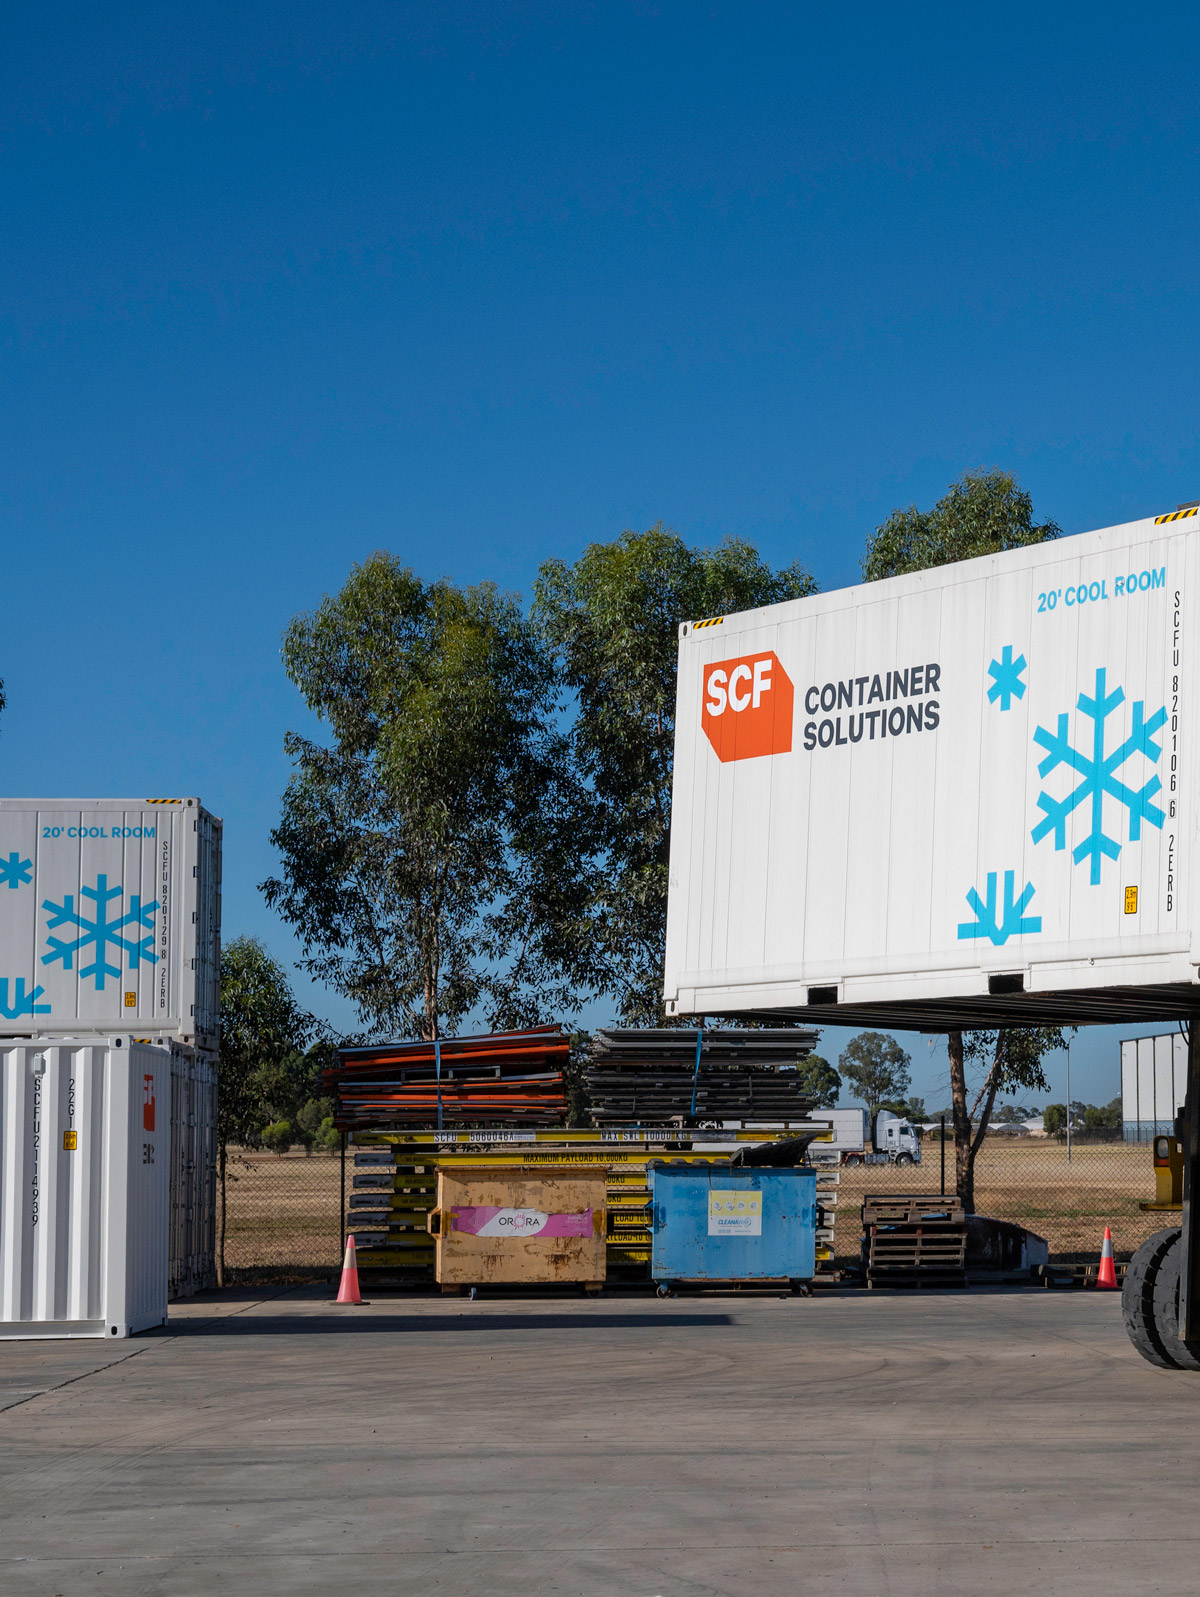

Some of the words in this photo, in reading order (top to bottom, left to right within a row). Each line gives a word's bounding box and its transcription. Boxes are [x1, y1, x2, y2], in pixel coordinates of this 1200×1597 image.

[1037, 588, 1062, 613] 20'
[1064, 579, 1108, 607] COOL
[1114, 566, 1166, 597] ROOM
[705, 658, 773, 717] SCF
[804, 663, 941, 716] CONTAINER
[803, 700, 941, 751] SOLUTIONS
[1170, 675, 1178, 792] 820106
[42, 826, 65, 839] 20'
[67, 826, 108, 839] COOL
[112, 826, 156, 839] ROOM
[1167, 834, 1175, 912] 2ERB
[67, 1078, 76, 1129] 22G1
[434, 1132, 458, 1142] SCFU
[523, 1153, 560, 1163] MAXIMUM
[561, 1153, 593, 1162] PAYLOAD
[601, 1131, 618, 1141] MAX
[623, 1131, 639, 1141] SWL
[644, 1131, 671, 1141] 10000
[675, 1131, 687, 1140] KG
